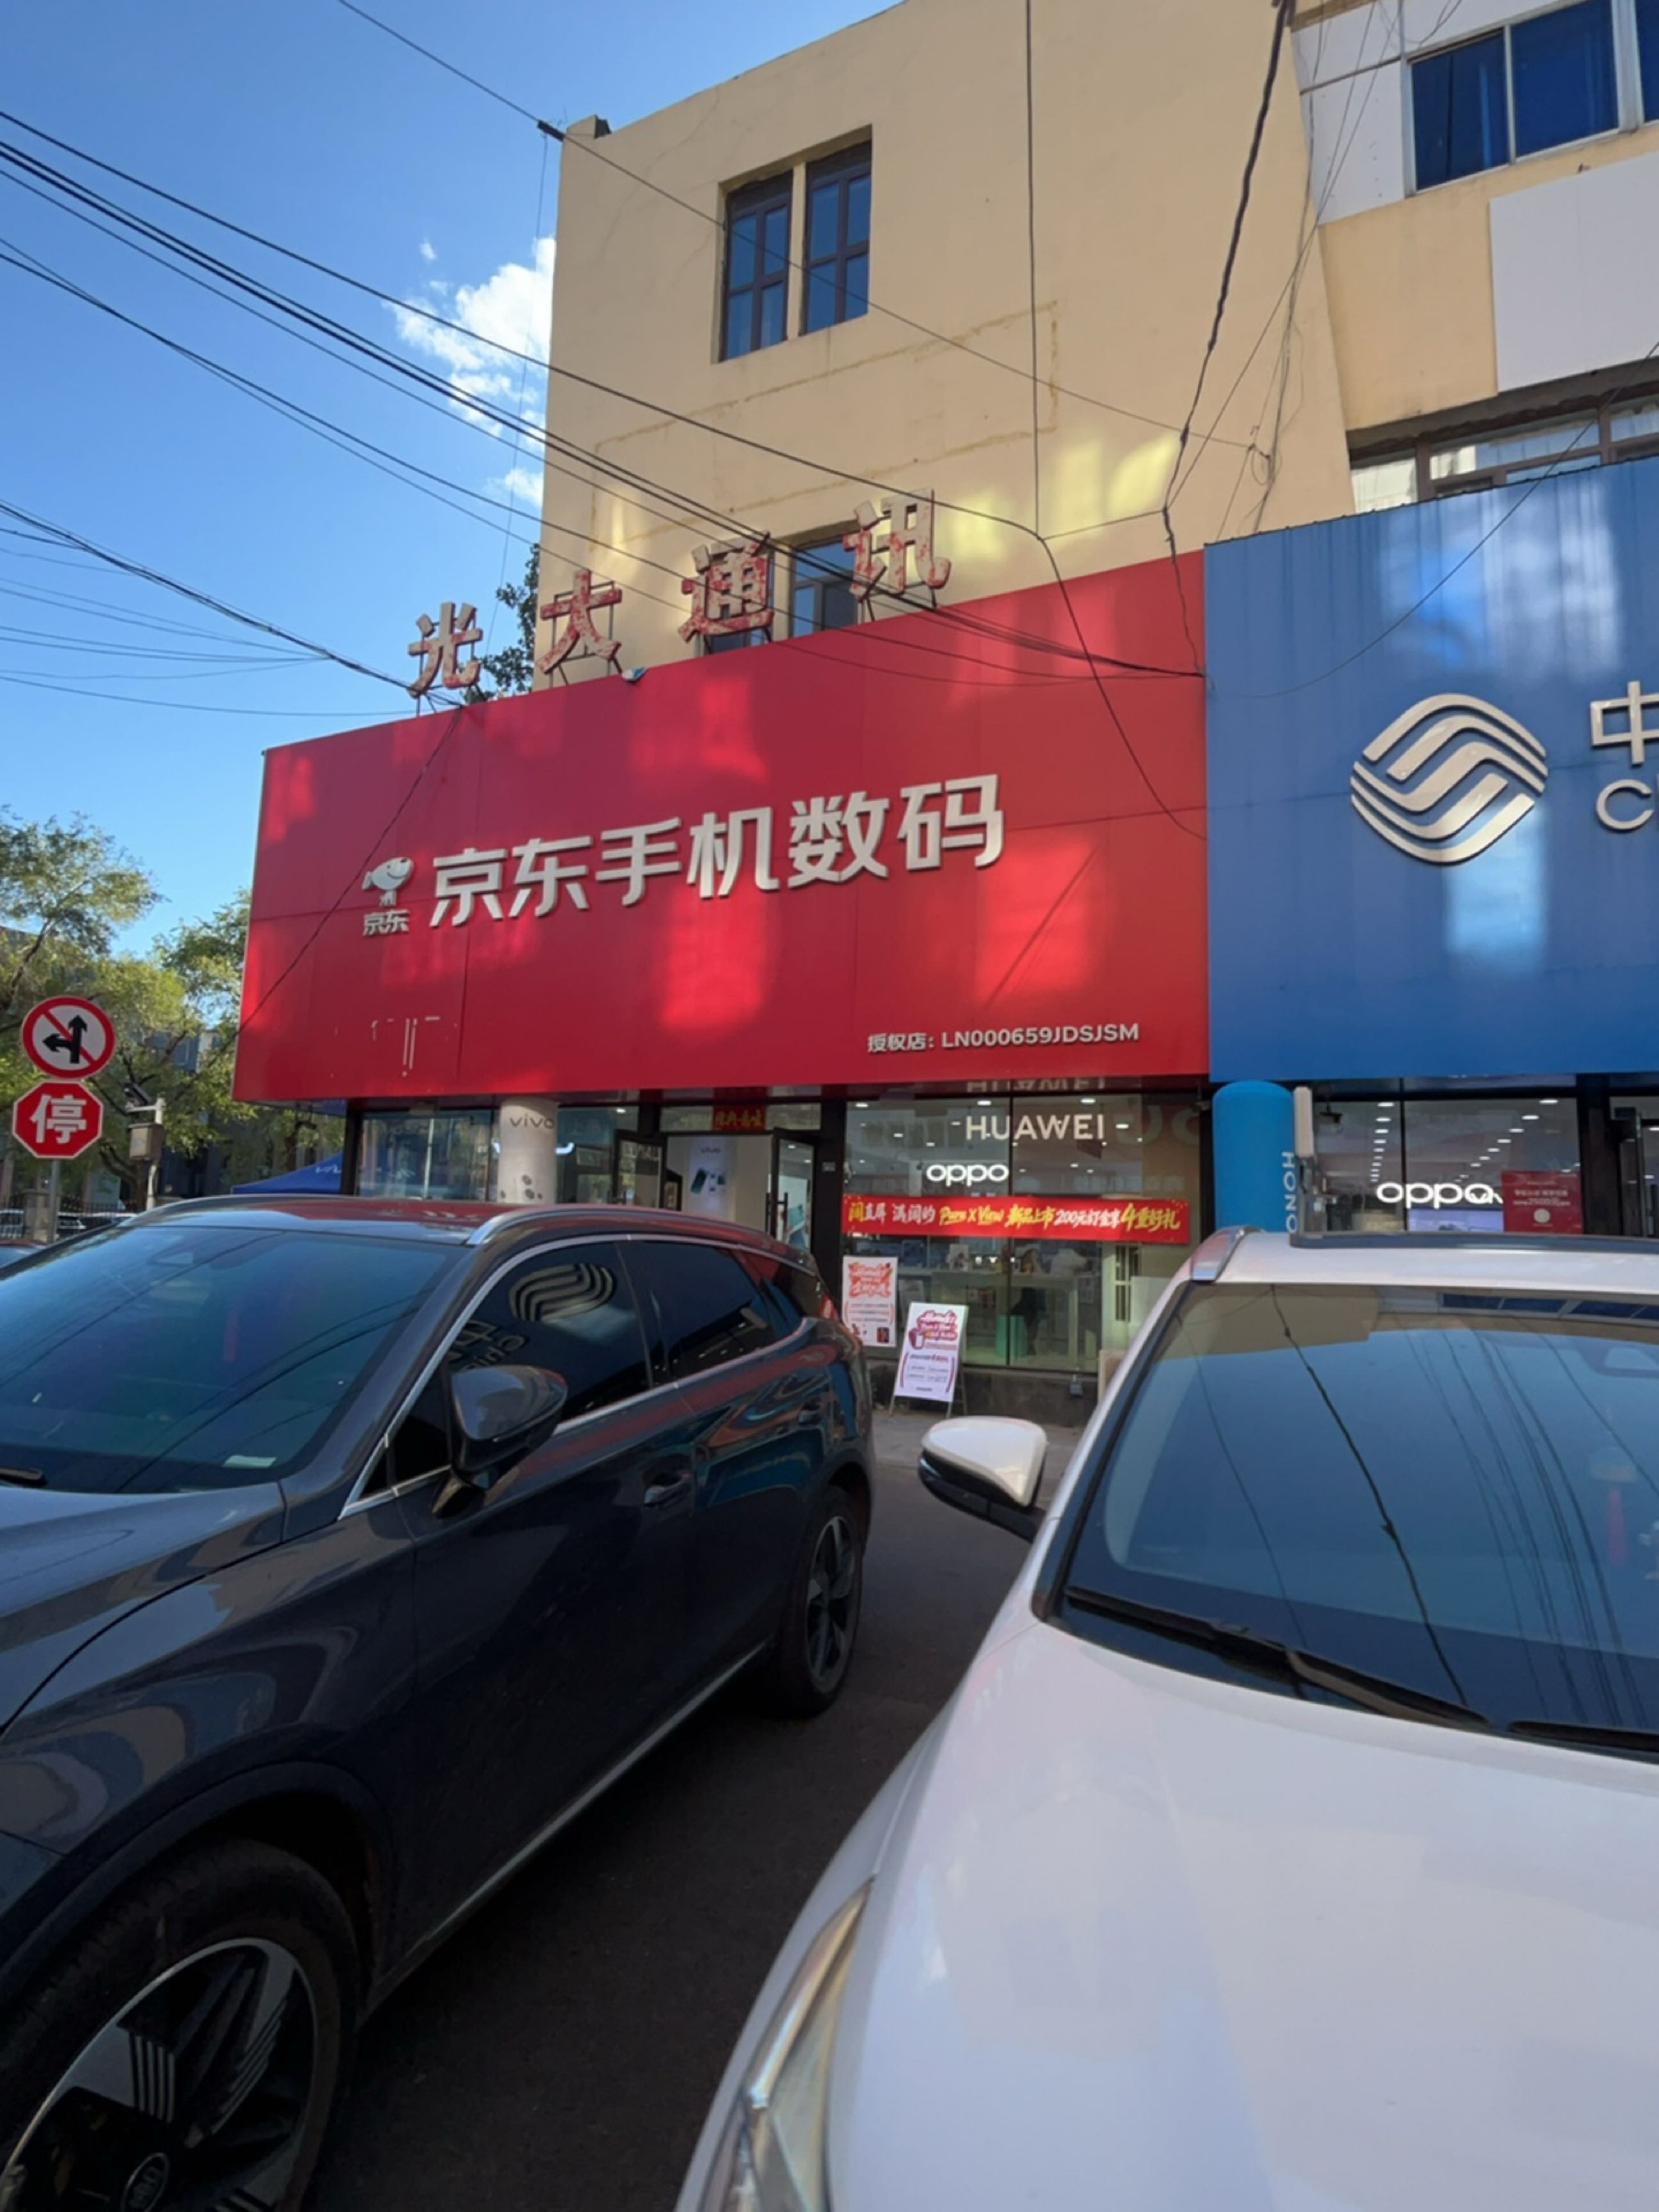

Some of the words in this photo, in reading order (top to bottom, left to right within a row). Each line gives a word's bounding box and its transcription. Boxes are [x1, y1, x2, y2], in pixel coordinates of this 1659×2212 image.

[408, 490, 951, 698] 光大通讯
[1590, 680, 1659, 765] 中
[1596, 779, 1659, 830] C
[429, 773, 1005, 927] 京东手机数码
[363, 909, 410, 936] 京东
[942, 1023, 1139, 1048] LN000659JDSJSM
[30, 1095, 87, 1144] 停
[509, 1114, 554, 1130] vivo
[966, 1114, 1105, 1141] HUAWEI
[926, 1164, 1009, 1187] oppo
